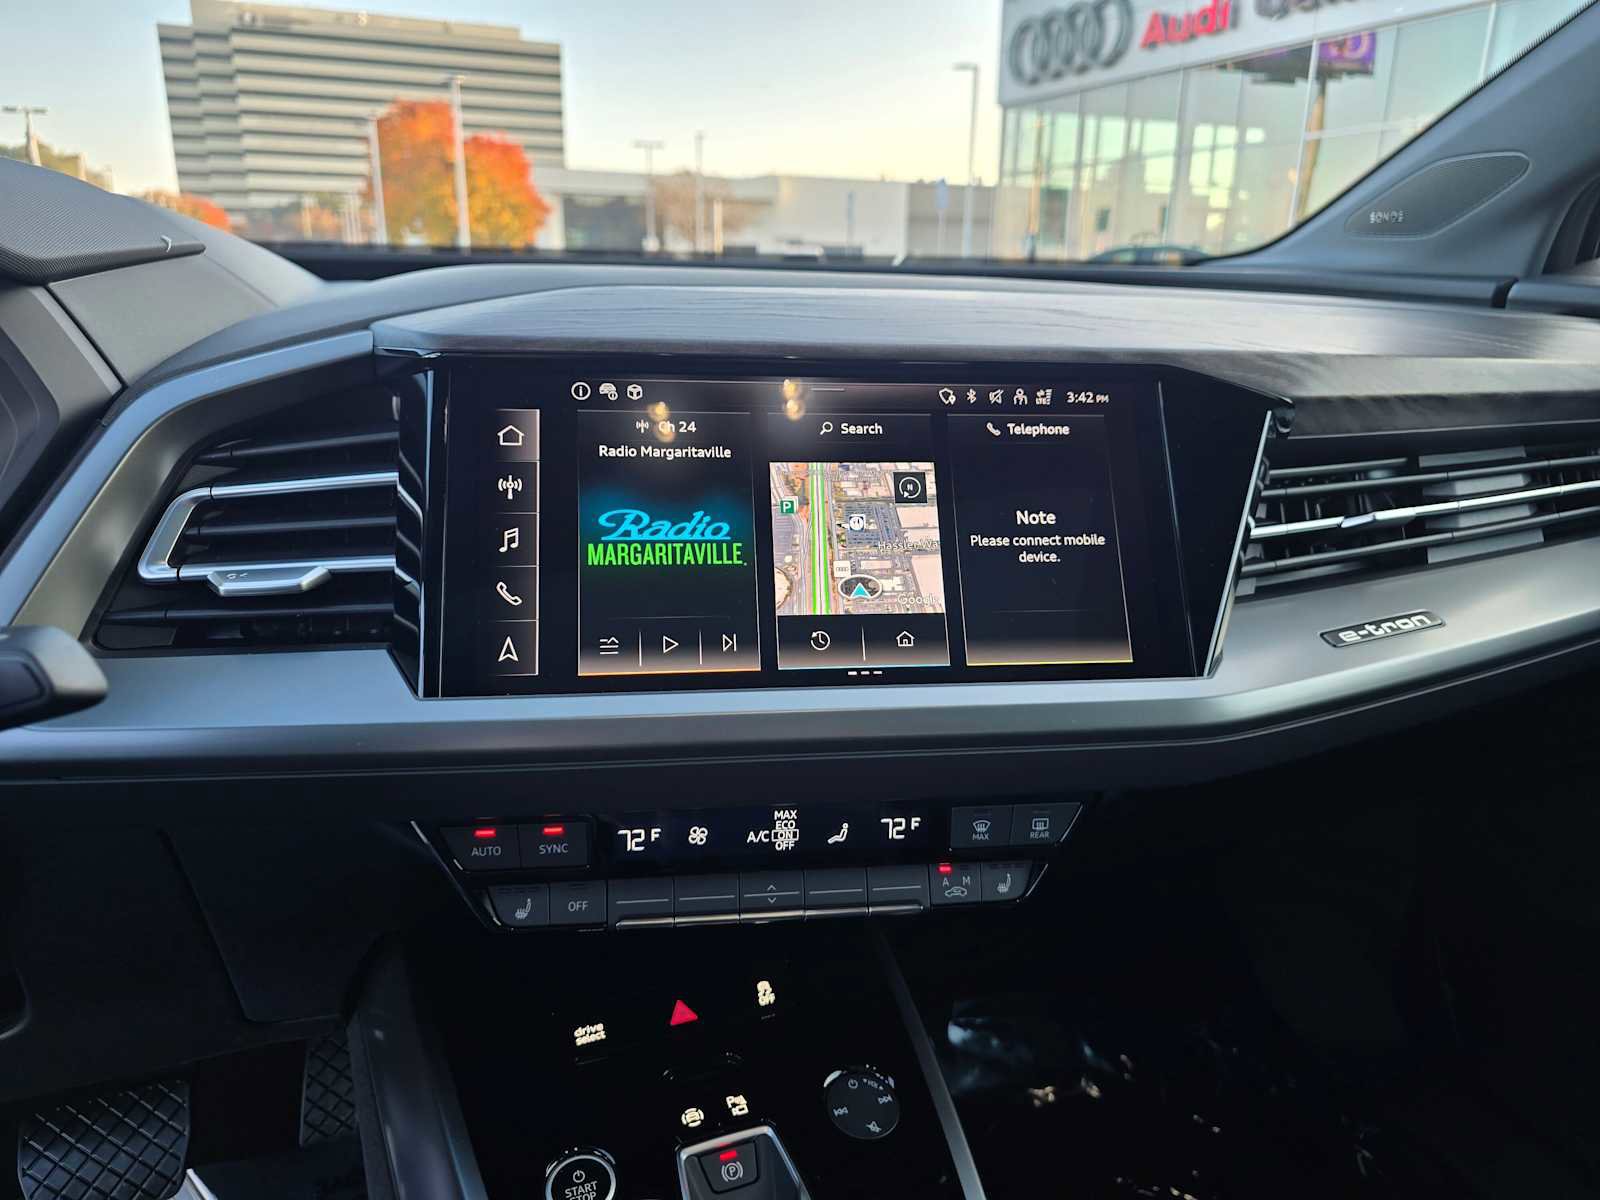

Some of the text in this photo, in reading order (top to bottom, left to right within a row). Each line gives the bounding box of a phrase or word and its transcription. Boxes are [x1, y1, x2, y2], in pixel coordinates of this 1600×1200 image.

[1139, 0, 1231, 49] Audi
[1066, 391, 1110, 404] 3:42 PM
[658, 420, 697, 433] Ch 24
[840, 422, 883, 435] Search
[1007, 422, 1070, 437] Telephone
[599, 444, 732, 461] Radio Margaritaville
[1016, 510, 1057, 525] Note
[598, 508, 731, 541] Radio
[970, 533, 1106, 548] Please connect mobile
[1018, 550, 1062, 564] device.
[1338, 614, 1431, 642] e-tron
[774, 810, 797, 820] MAX
[776, 820, 796, 830] ECO
[881, 817, 921, 839] 72 F
[618, 828, 662, 851] 72 F
[747, 830, 770, 843] A/C
[777, 831, 793, 840] ON
[972, 833, 991, 841] MAX
[1030, 831, 1050, 839] REAR
[471, 846, 502, 856] AUTO
[538, 843, 569, 854] SYNC
[775, 840, 795, 851] OFF
[942, 877, 950, 887] A
[962, 876, 971, 886] M
[568, 900, 589, 912] OFF
[574, 1024, 604, 1037] drive
[576, 1030, 606, 1046] select
[565, 1181, 598, 1198] START
